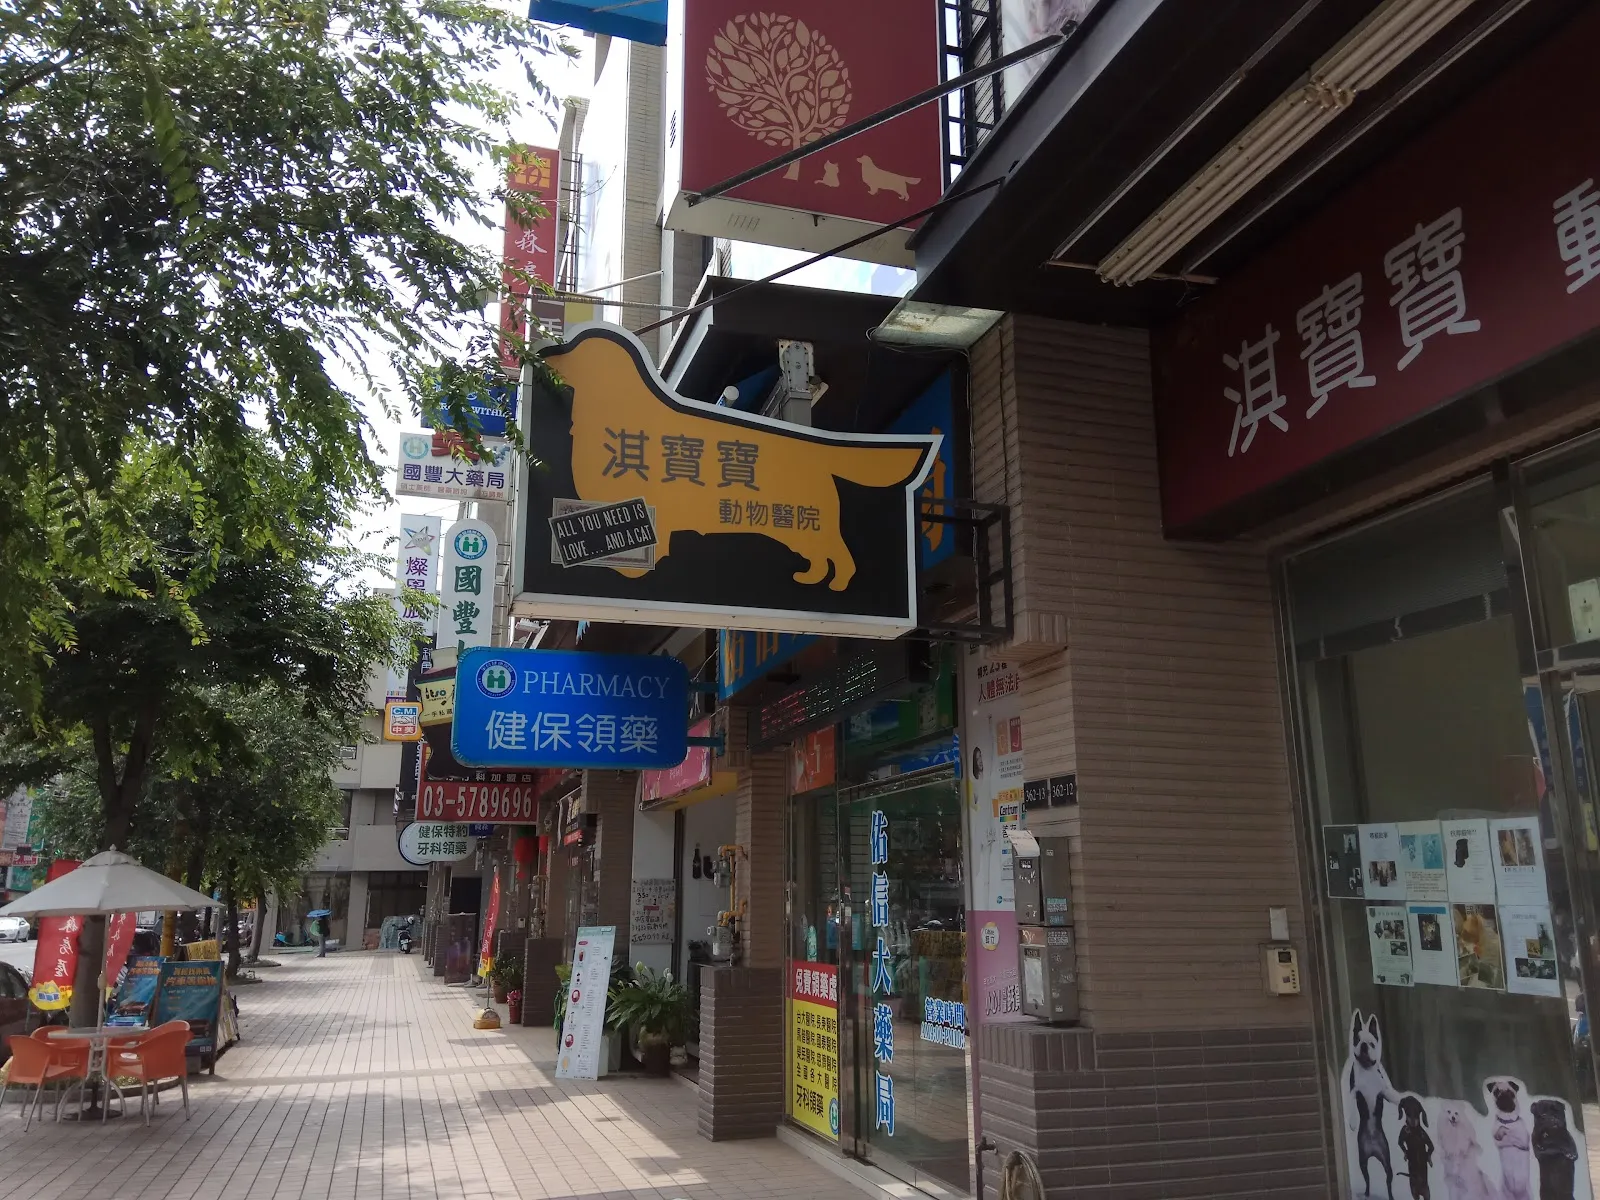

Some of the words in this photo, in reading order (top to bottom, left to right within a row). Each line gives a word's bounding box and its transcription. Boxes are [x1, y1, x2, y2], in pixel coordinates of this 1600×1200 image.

[1222, 206, 1481, 458] 淇寶寶
[601, 426, 761, 492] 淇寶寶
[402, 463, 505, 490] 國豐大藥局
[556, 520, 578, 540] ALL
[577, 513, 601, 533] YOU
[603, 506, 631, 528] NEED
[633, 502, 645, 520] IS
[718, 498, 821, 532] 動物醫院
[605, 530, 626, 552] AND
[627, 529, 636, 547] A
[635, 524, 653, 545] CAT
[452, 564, 483, 655] 國豐
[522, 670, 671, 699] PHARMACY
[392, 707, 417, 715] C.M.
[392, 726, 416, 734] 中美
[484, 709, 659, 754] 健保領藥
[422, 784, 532, 818] 03-5789696
[1025, 787, 1046, 802] 362-13
[1052, 782, 1074, 798] 362-12
[417, 841, 468, 856] 牙科領藥
[418, 825, 468, 839] 健保特約
[795, 968, 838, 1002] 免費領藥處
[869, 809, 895, 1136] 佑信大藥局
[924, 996, 965, 1029] 營業時間
[796, 1084, 824, 1119] 牙科領藥
